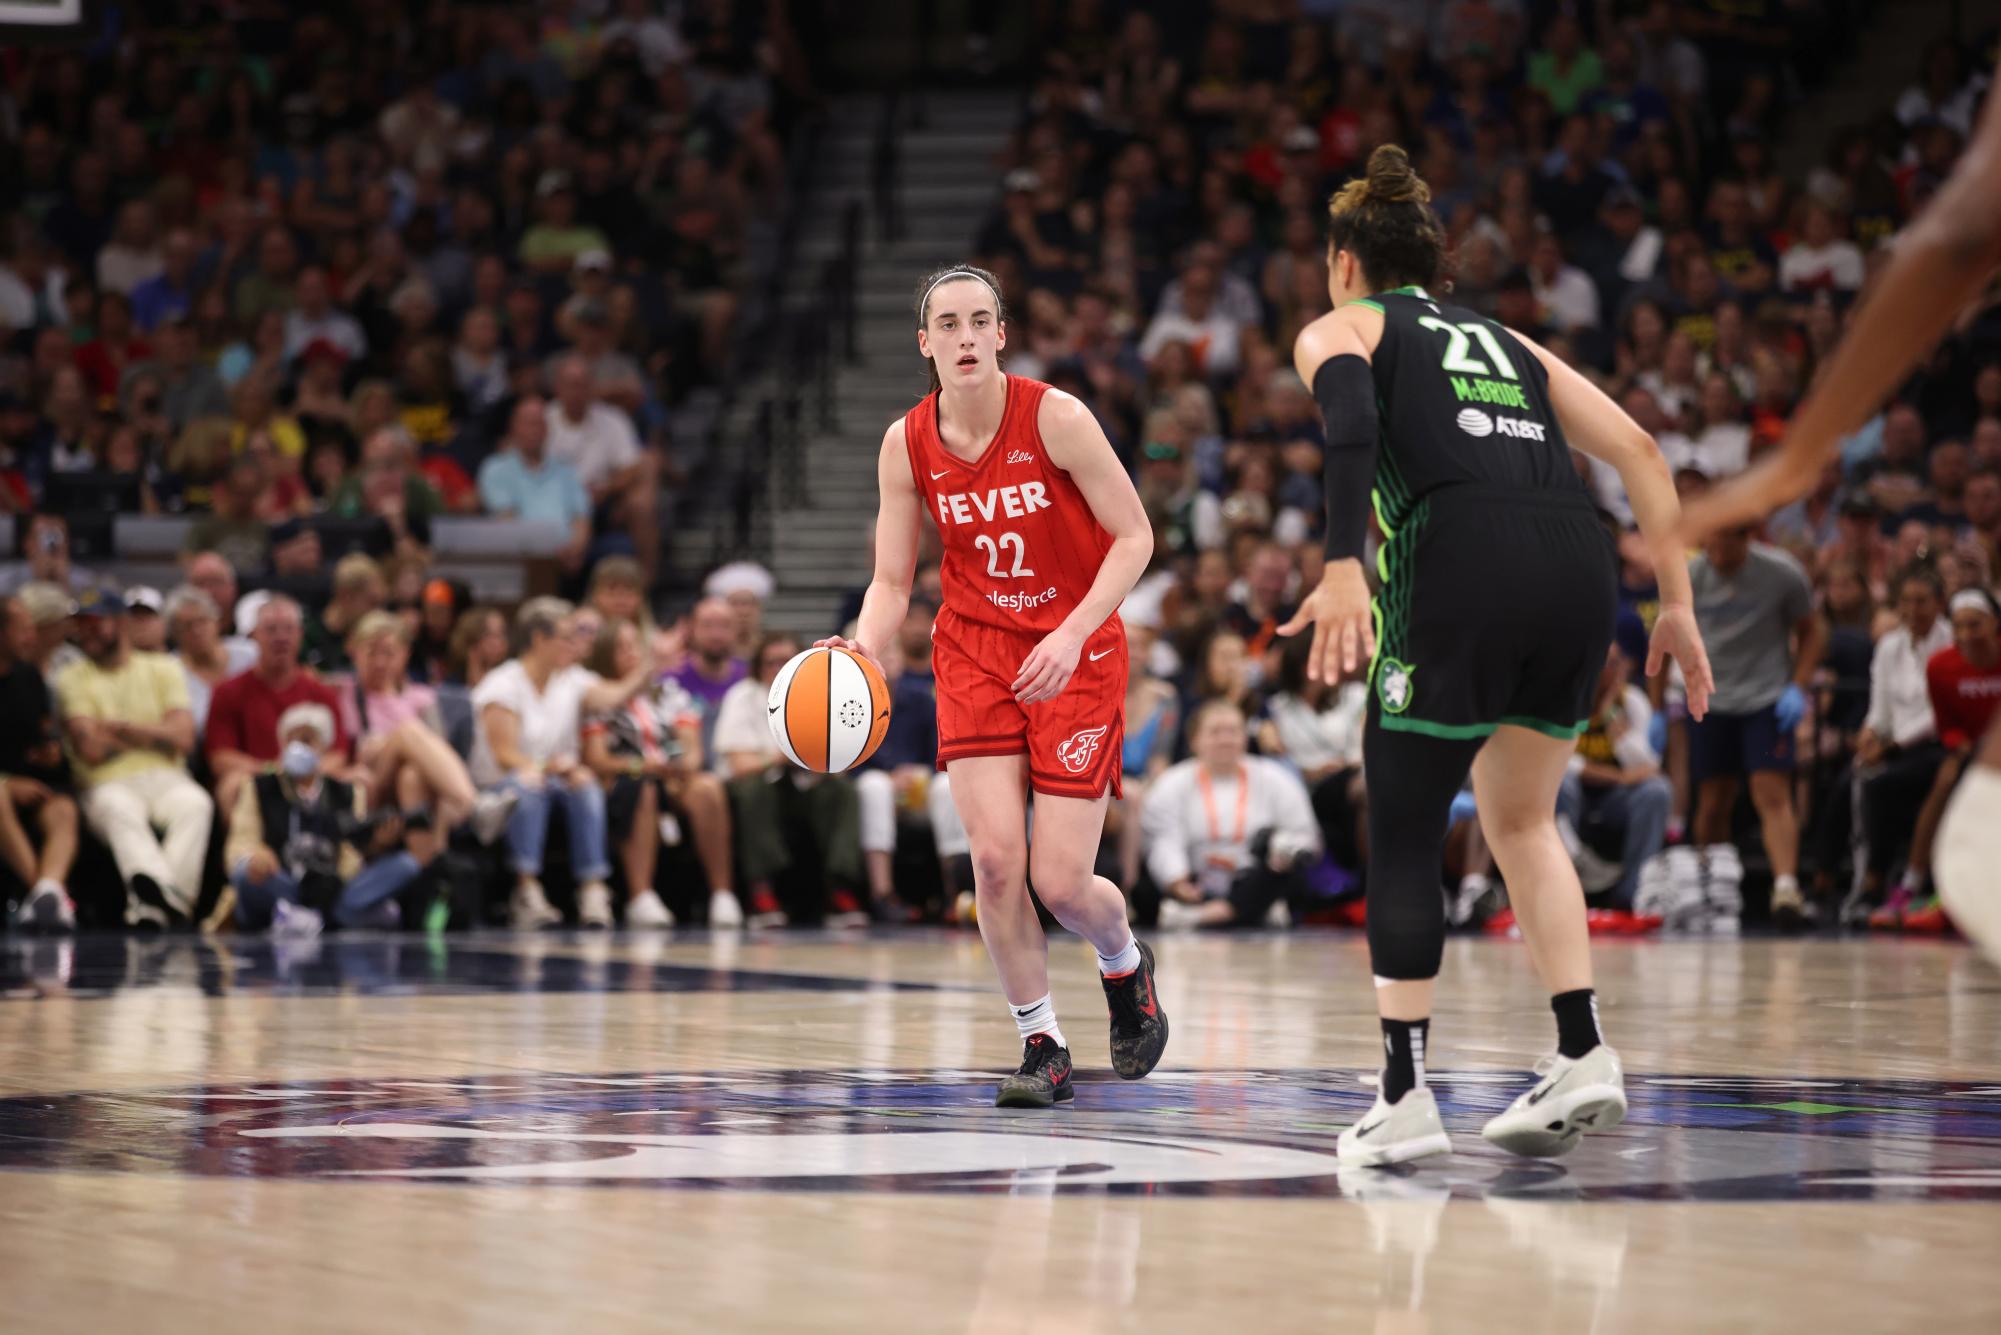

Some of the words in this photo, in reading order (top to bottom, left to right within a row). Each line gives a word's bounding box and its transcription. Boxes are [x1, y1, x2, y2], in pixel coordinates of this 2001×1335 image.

[1417, 315, 1520, 381] 21
[1450, 376, 1530, 410] McBRIDE
[1496, 415, 1546, 442] AT&T
[1006, 449, 1035, 464] Lilly
[936, 481, 1053, 525] FEVER
[974, 532, 1035, 578] 22
